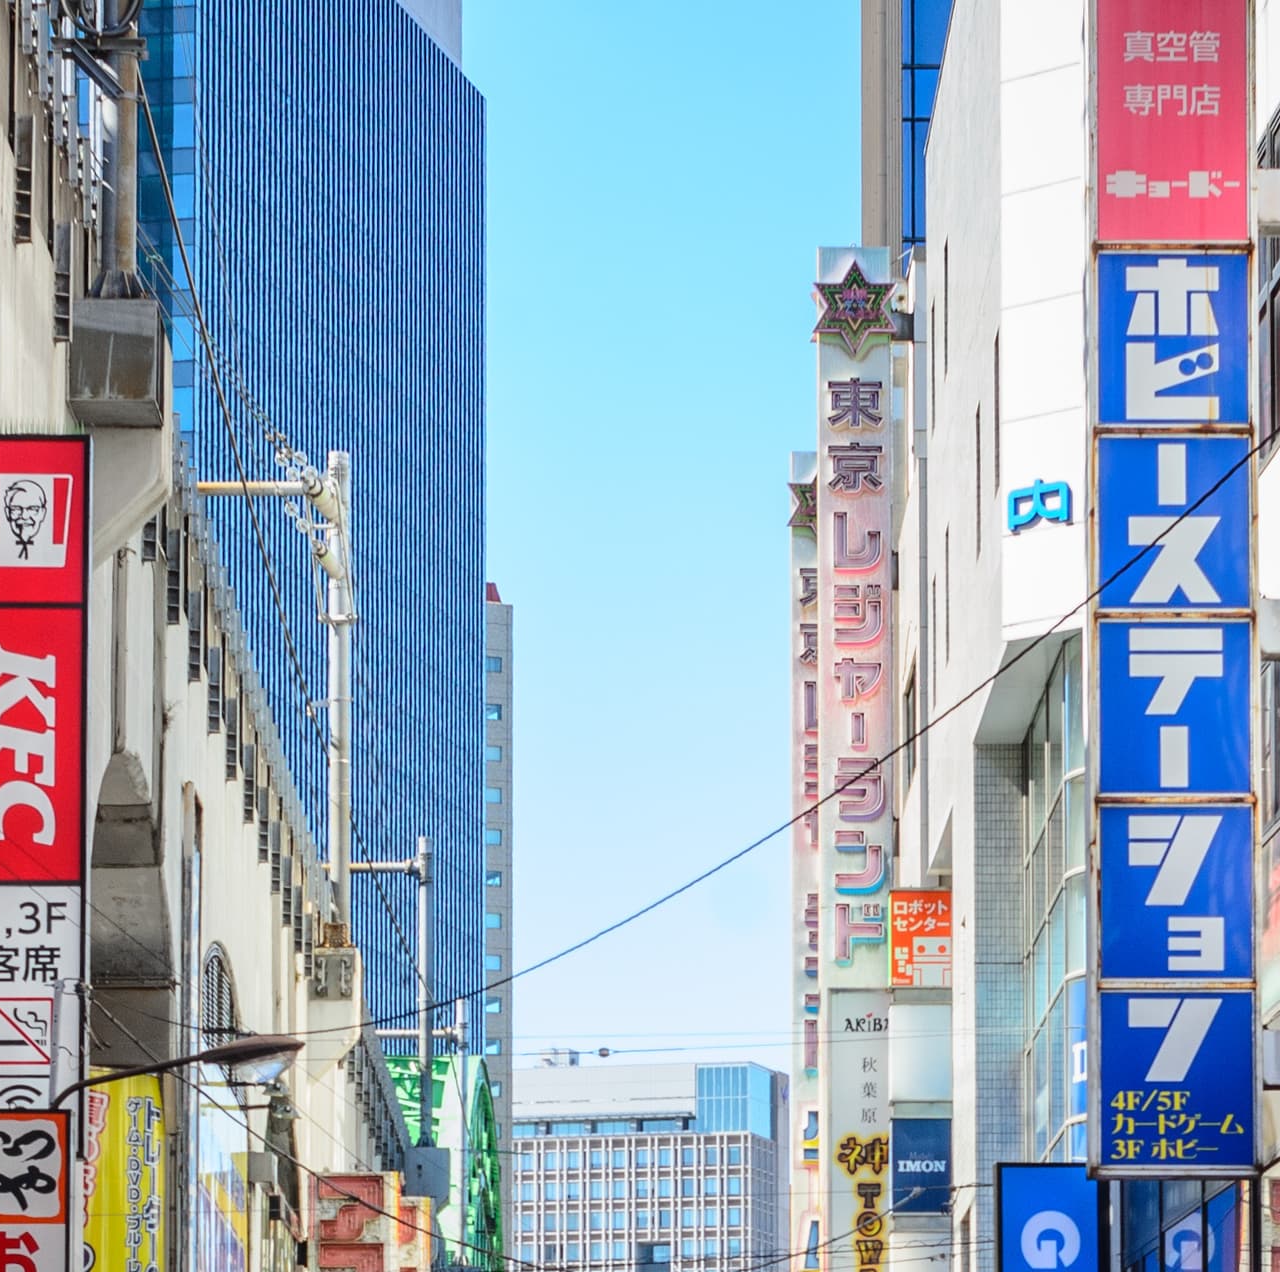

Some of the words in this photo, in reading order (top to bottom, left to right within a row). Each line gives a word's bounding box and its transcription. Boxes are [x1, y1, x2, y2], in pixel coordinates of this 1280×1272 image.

[1123, 31, 1220, 64] 真空管
[1123, 84, 1220, 117] 専門店
[1106, 170, 1240, 198] キョードー
[827, 377, 885, 972] 東京レジャーランド
[893, 900, 948, 915] ロボット
[893, 917, 950, 933] センター
[860, 1056, 878, 1124] 秋葉原
[1110, 1089, 1191, 1112] 4F/5F
[1111, 1112, 1245, 1135] カードゲーム
[1110, 1139, 1145, 1160] 3F
[1151, 1138, 1219, 1160] ホビー
[897, 1160, 947, 1173] IMON
